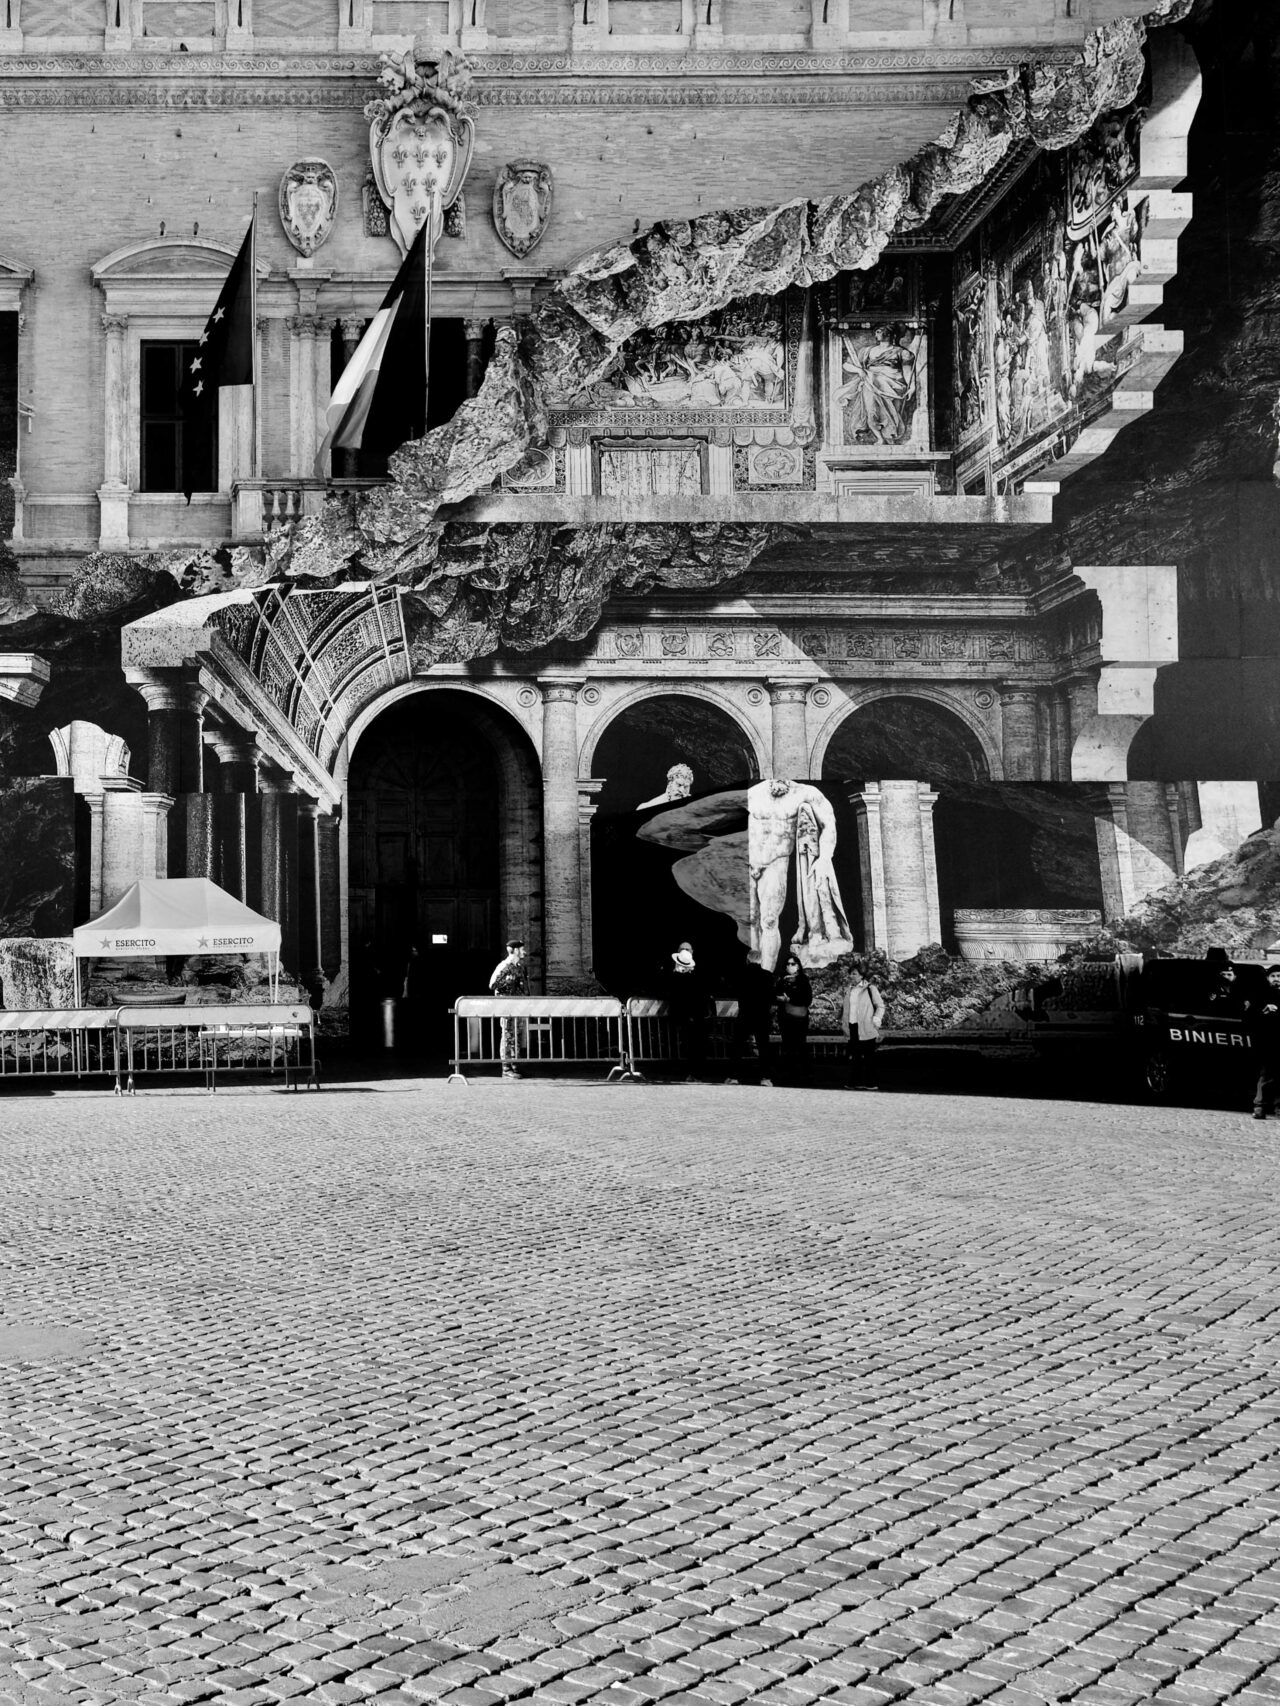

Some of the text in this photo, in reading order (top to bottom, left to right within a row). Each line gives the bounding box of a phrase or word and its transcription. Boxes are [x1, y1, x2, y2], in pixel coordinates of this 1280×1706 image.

[115, 939, 156, 947] ESERCITO
[213, 937, 254, 946] ESERCITO
[1134, 1015, 1144, 1026] 112
[1169, 1028, 1252, 1047] BINIERI
